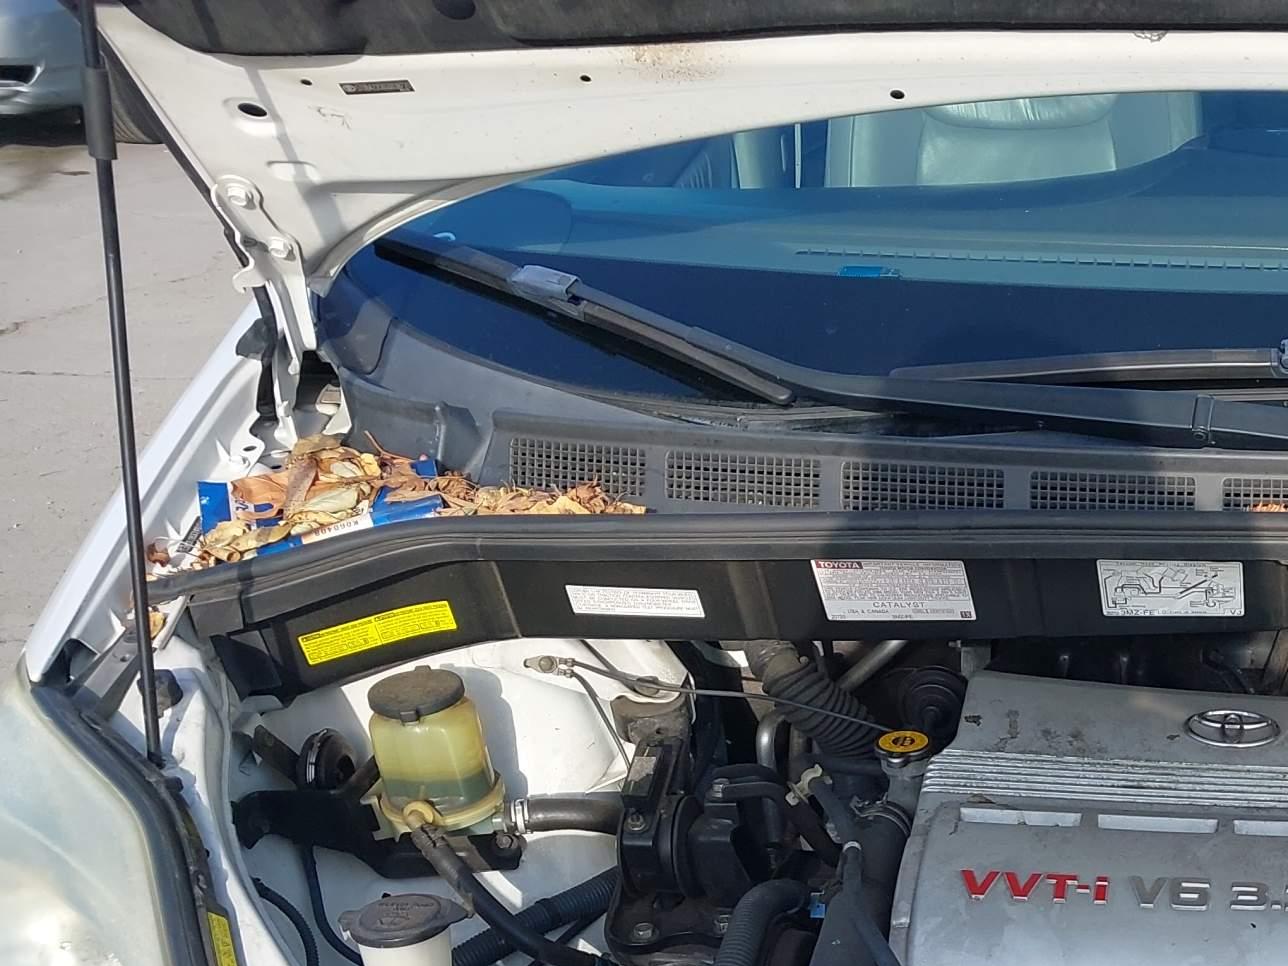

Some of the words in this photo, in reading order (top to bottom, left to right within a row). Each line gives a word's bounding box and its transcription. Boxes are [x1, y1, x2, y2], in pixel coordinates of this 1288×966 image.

[818, 561, 859, 569] TOYOTA
[960, 869, 1111, 904] VVT-i
[1128, 876, 1212, 911] V6
